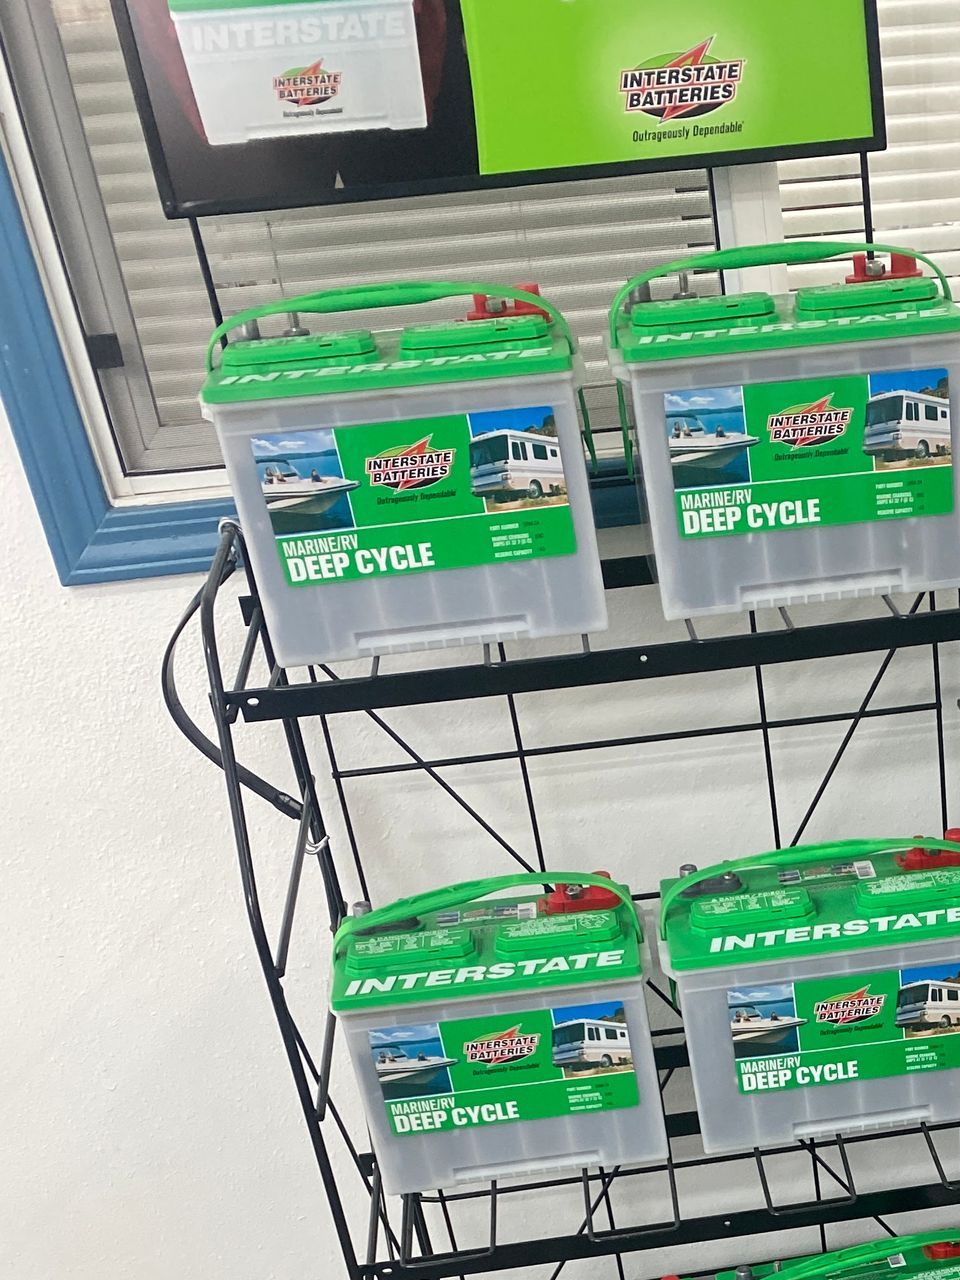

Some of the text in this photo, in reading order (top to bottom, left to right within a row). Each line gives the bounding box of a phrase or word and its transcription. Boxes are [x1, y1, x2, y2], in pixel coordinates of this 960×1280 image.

[191, 12, 405, 50] INTERSTATE
[274, 73, 340, 87] INTERSTATE
[623, 63, 740, 88] INTERSTATE
[279, 86, 337, 99] BATTERIES
[629, 83, 733, 107] BATTERIES
[633, 121, 743, 142] Outrageously Dependable
[639, 308, 950, 345] INTERSTATE
[219, 347, 552, 386] INTERSTATE
[770, 411, 848, 427] INTERSTATE
[773, 424, 844, 439] BATTERIES
[368, 452, 451, 471] INTERSTATE
[373, 465, 448, 482] BATTERIES
[680, 488, 752, 510] MARINE/RV
[682, 498, 821, 535] DEEP CYCLE
[282, 533, 359, 558] MARINE/RV
[287, 542, 436, 582] DEEP CYCLE
[344, 949, 626, 997] INTERSTATE
[816, 996, 884, 1012] INTERSTATE
[819, 1006, 879, 1020] BATTERIES
[466, 1036, 537, 1052] INTERSTATE
[470, 1045, 533, 1060] BATTERIES
[740, 1056, 801, 1074] MARINE/RV
[742, 1061, 859, 1092] DEEP CYCLE
[390, 1097, 456, 1116] MARINE/RV
[393, 1101, 520, 1133] DEEP CYCLE
